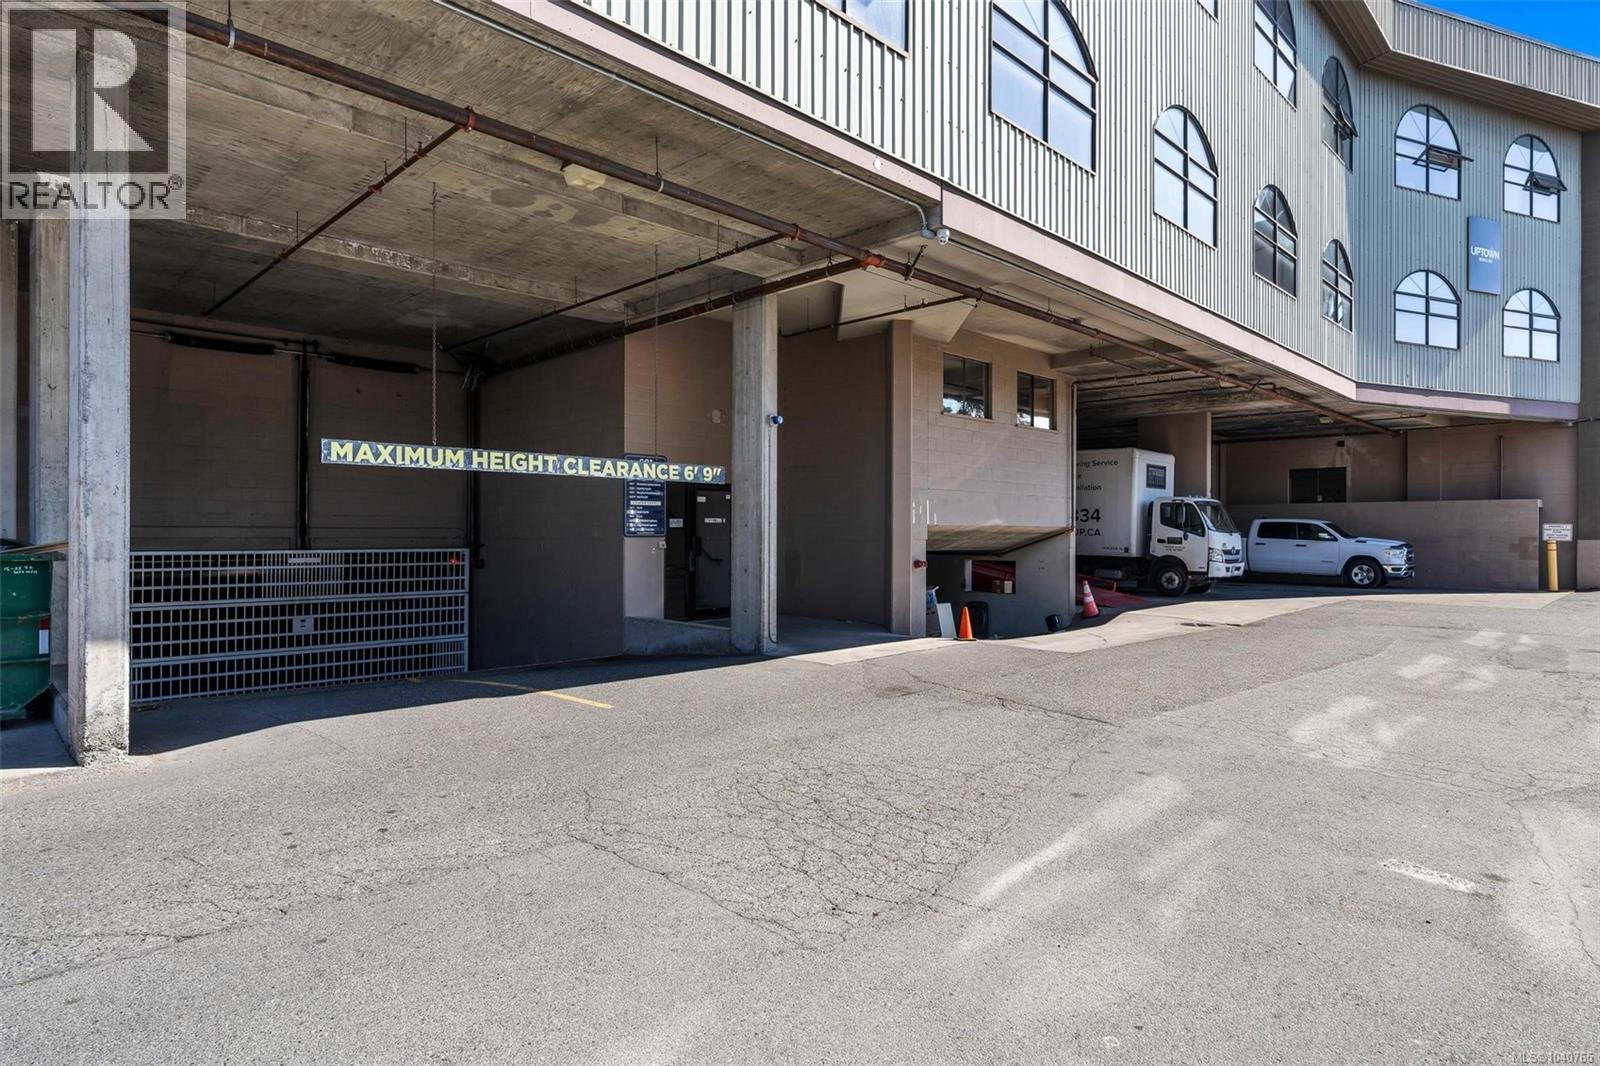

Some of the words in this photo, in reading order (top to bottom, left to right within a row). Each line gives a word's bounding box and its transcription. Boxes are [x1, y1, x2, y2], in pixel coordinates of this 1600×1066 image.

[1470, 246, 1500, 260] UPTOWN
[330, 441, 464, 468] MAXIMUM
[472, 450, 558, 473] HEIGHT
[563, 457, 680, 480] CLEARANCE
[684, 466, 698, 481] 6'
